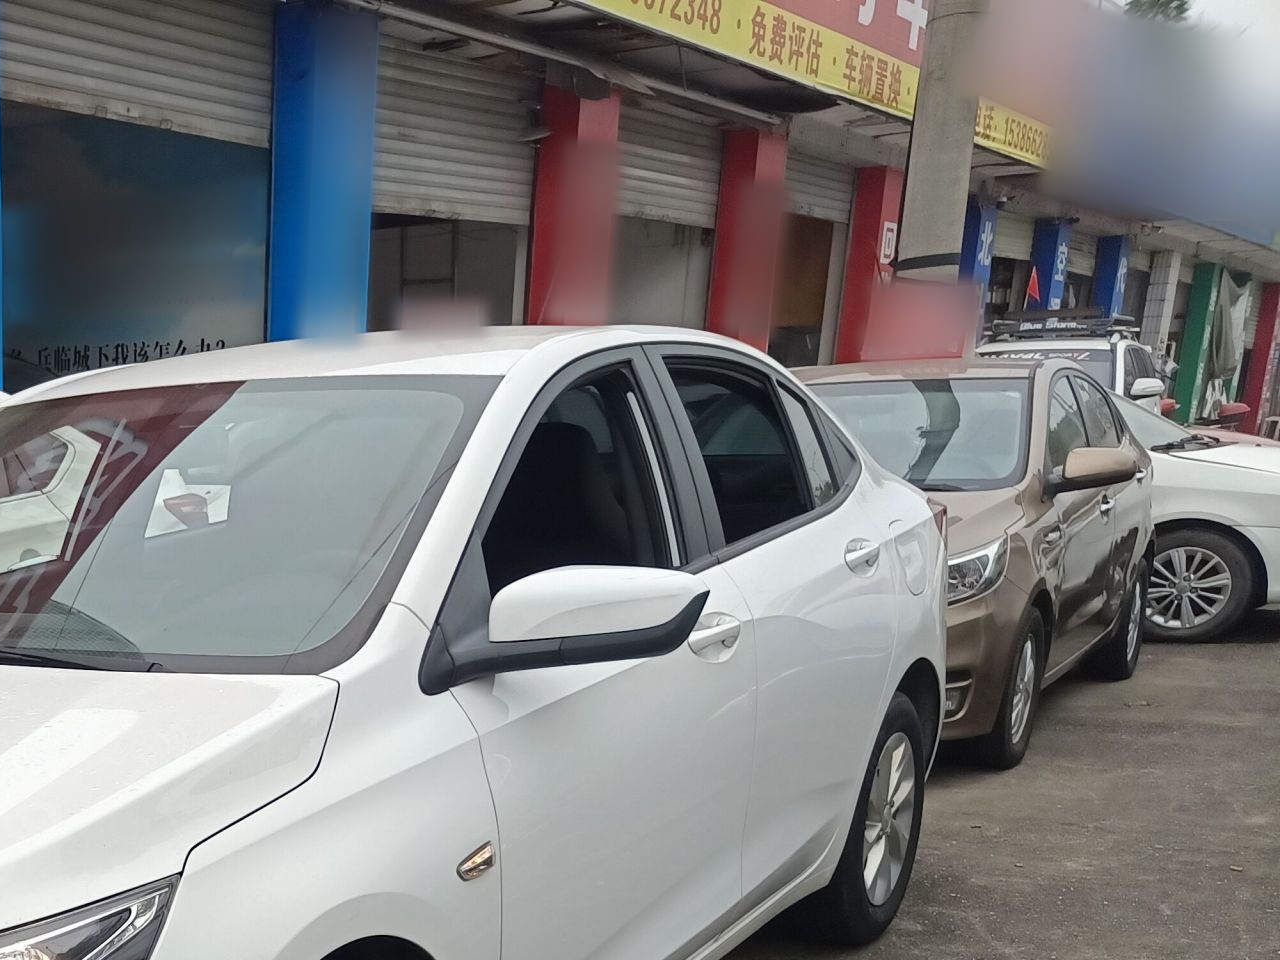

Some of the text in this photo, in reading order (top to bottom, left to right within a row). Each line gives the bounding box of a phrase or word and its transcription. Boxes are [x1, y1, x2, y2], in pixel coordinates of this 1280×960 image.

[749, 6, 823, 78] 免费评估
[842, 45, 903, 107] 车辆置换
